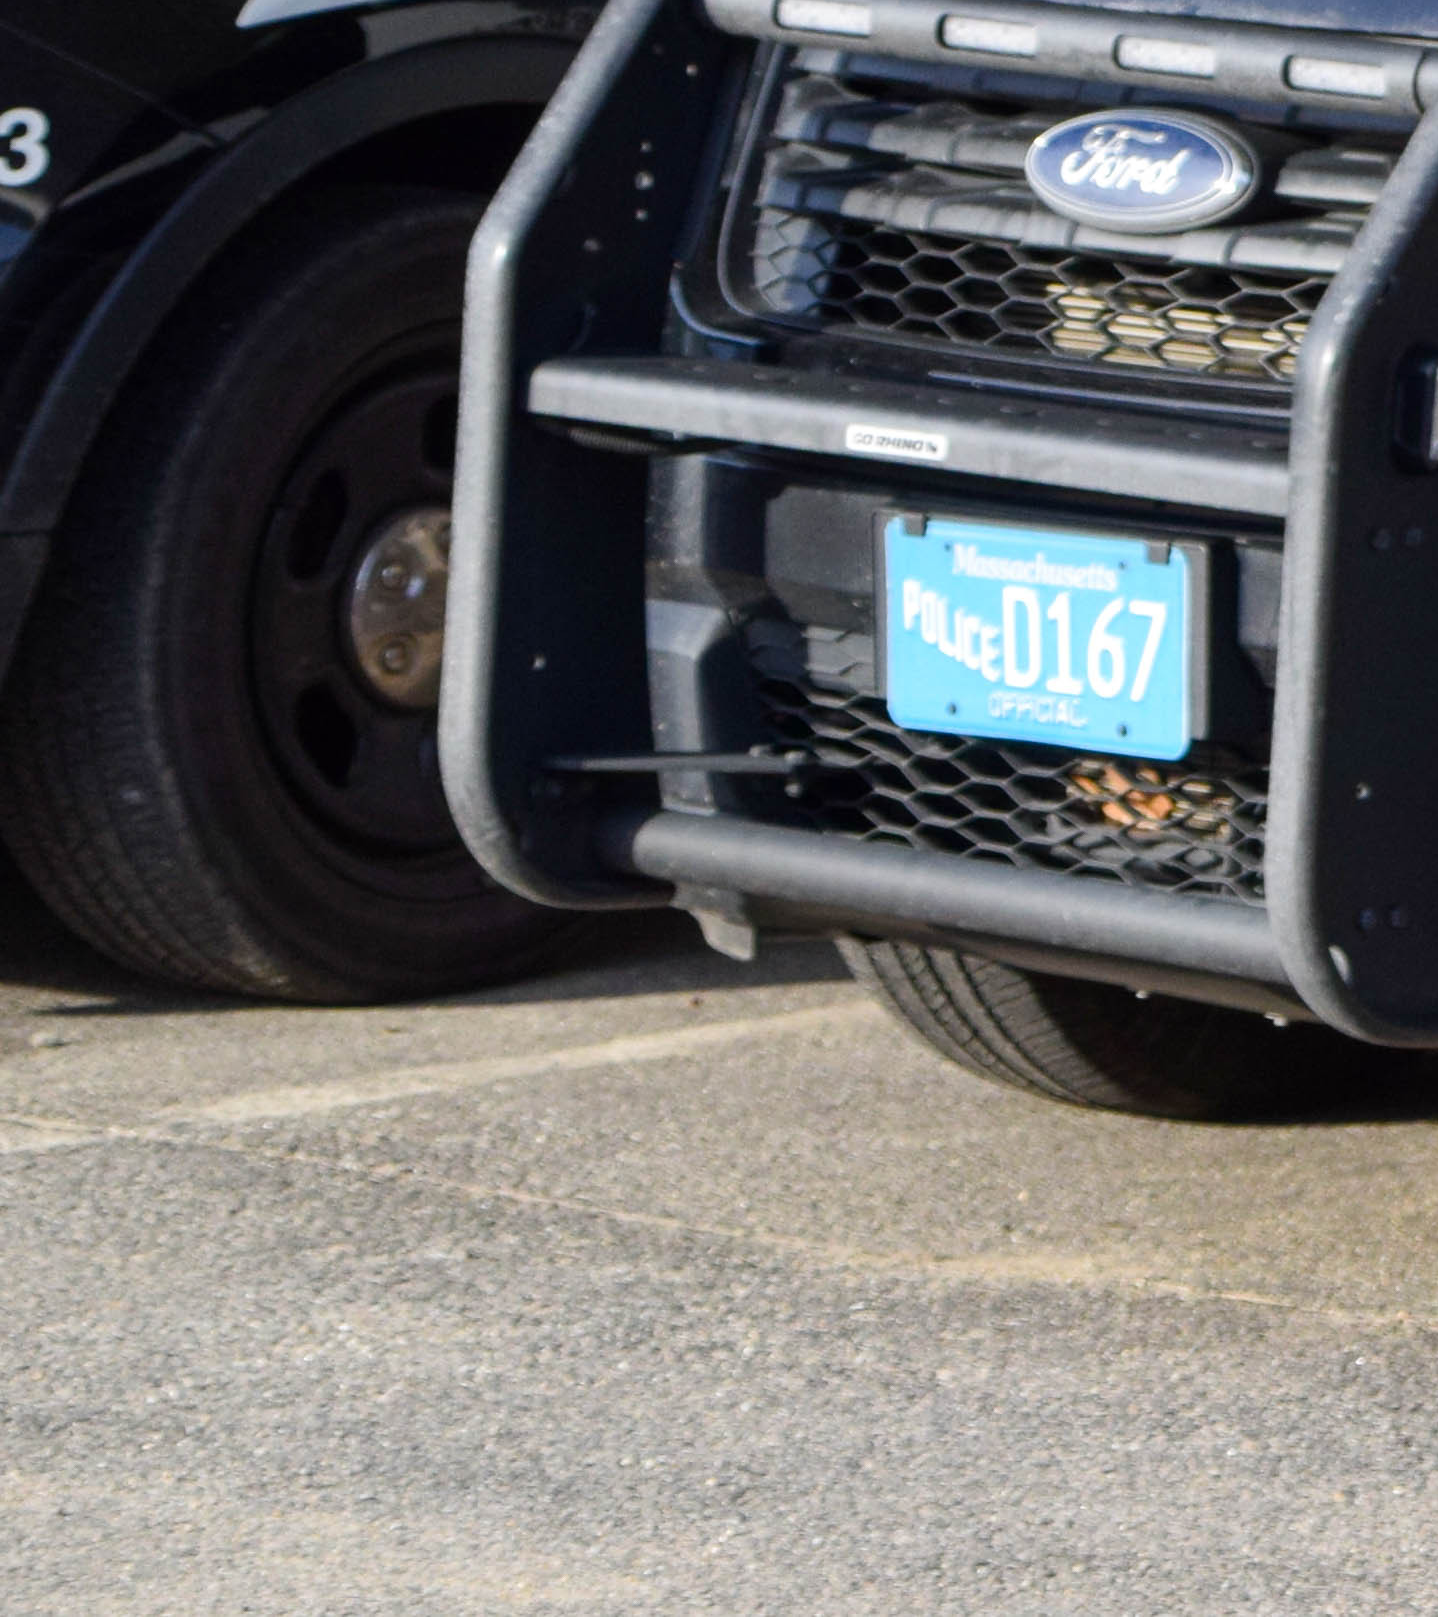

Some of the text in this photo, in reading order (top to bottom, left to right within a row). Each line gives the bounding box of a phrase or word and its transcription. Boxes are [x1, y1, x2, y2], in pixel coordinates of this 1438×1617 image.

[1060, 123, 1191, 195] Ford
[952, 543, 1118, 592] Massachusetts
[903, 578, 1167, 703] POLICE D167
[988, 690, 1088, 727] OFFICIAL
